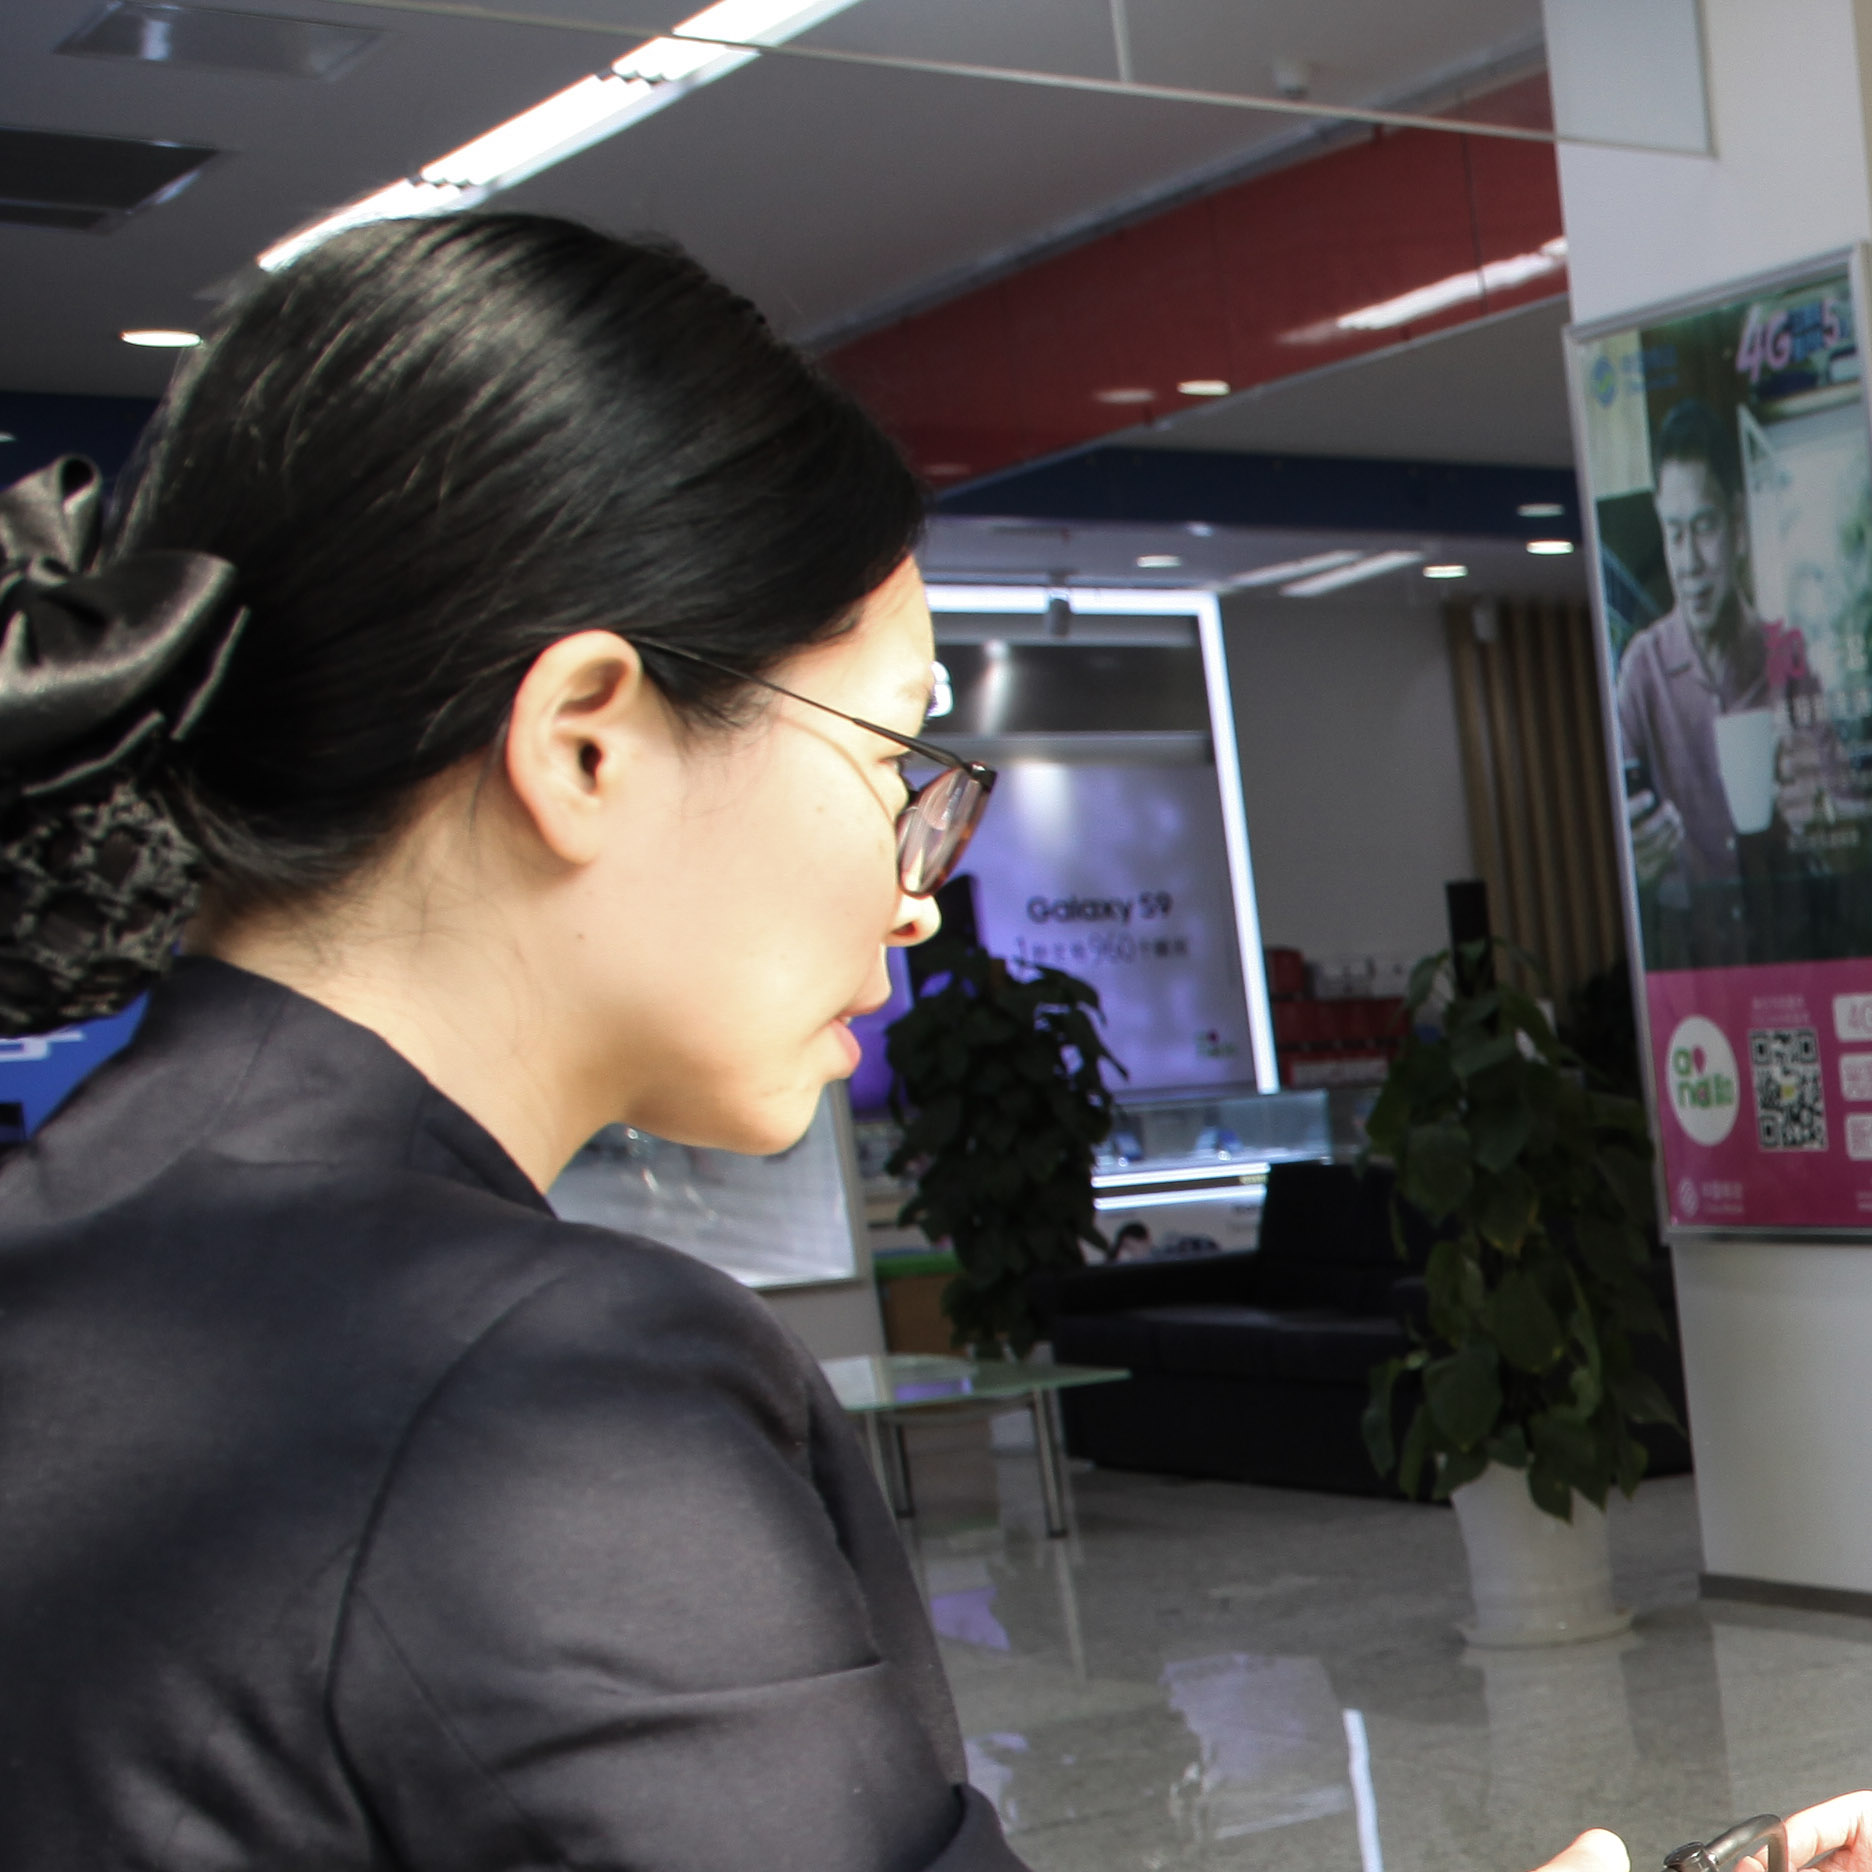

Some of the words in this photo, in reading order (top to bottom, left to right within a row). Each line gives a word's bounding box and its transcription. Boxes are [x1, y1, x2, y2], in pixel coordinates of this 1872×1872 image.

[1736, 302, 1792, 382] 4G
[1027, 893, 1132, 924] Galaxy
[1139, 890, 1173, 919] S9
